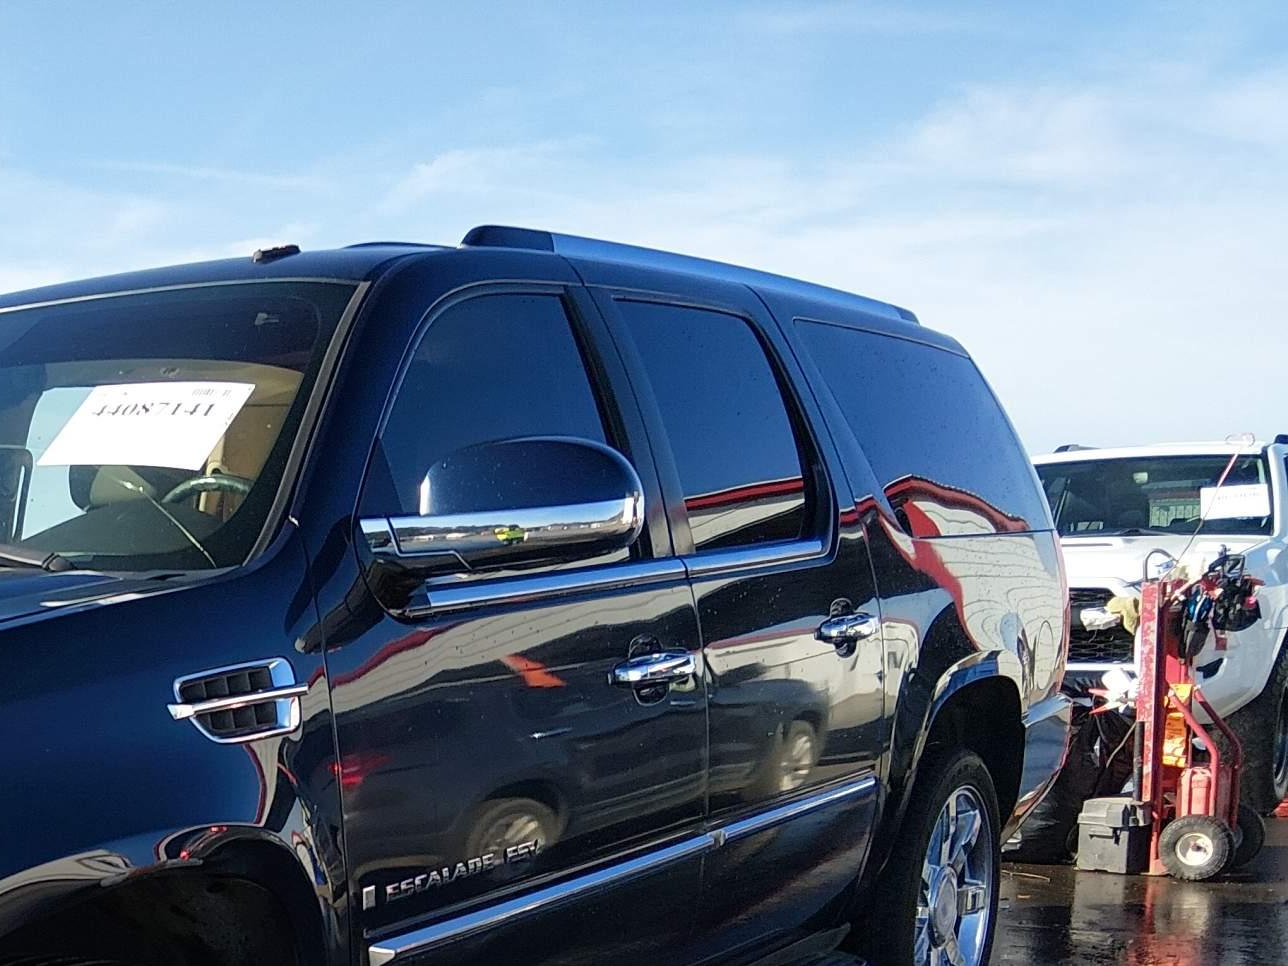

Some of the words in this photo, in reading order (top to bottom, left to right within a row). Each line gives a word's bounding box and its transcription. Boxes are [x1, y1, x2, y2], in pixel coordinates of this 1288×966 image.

[92, 401, 216, 417] 44087141
[385, 852, 496, 903] ESCALADE
[505, 839, 542, 864] ESV
